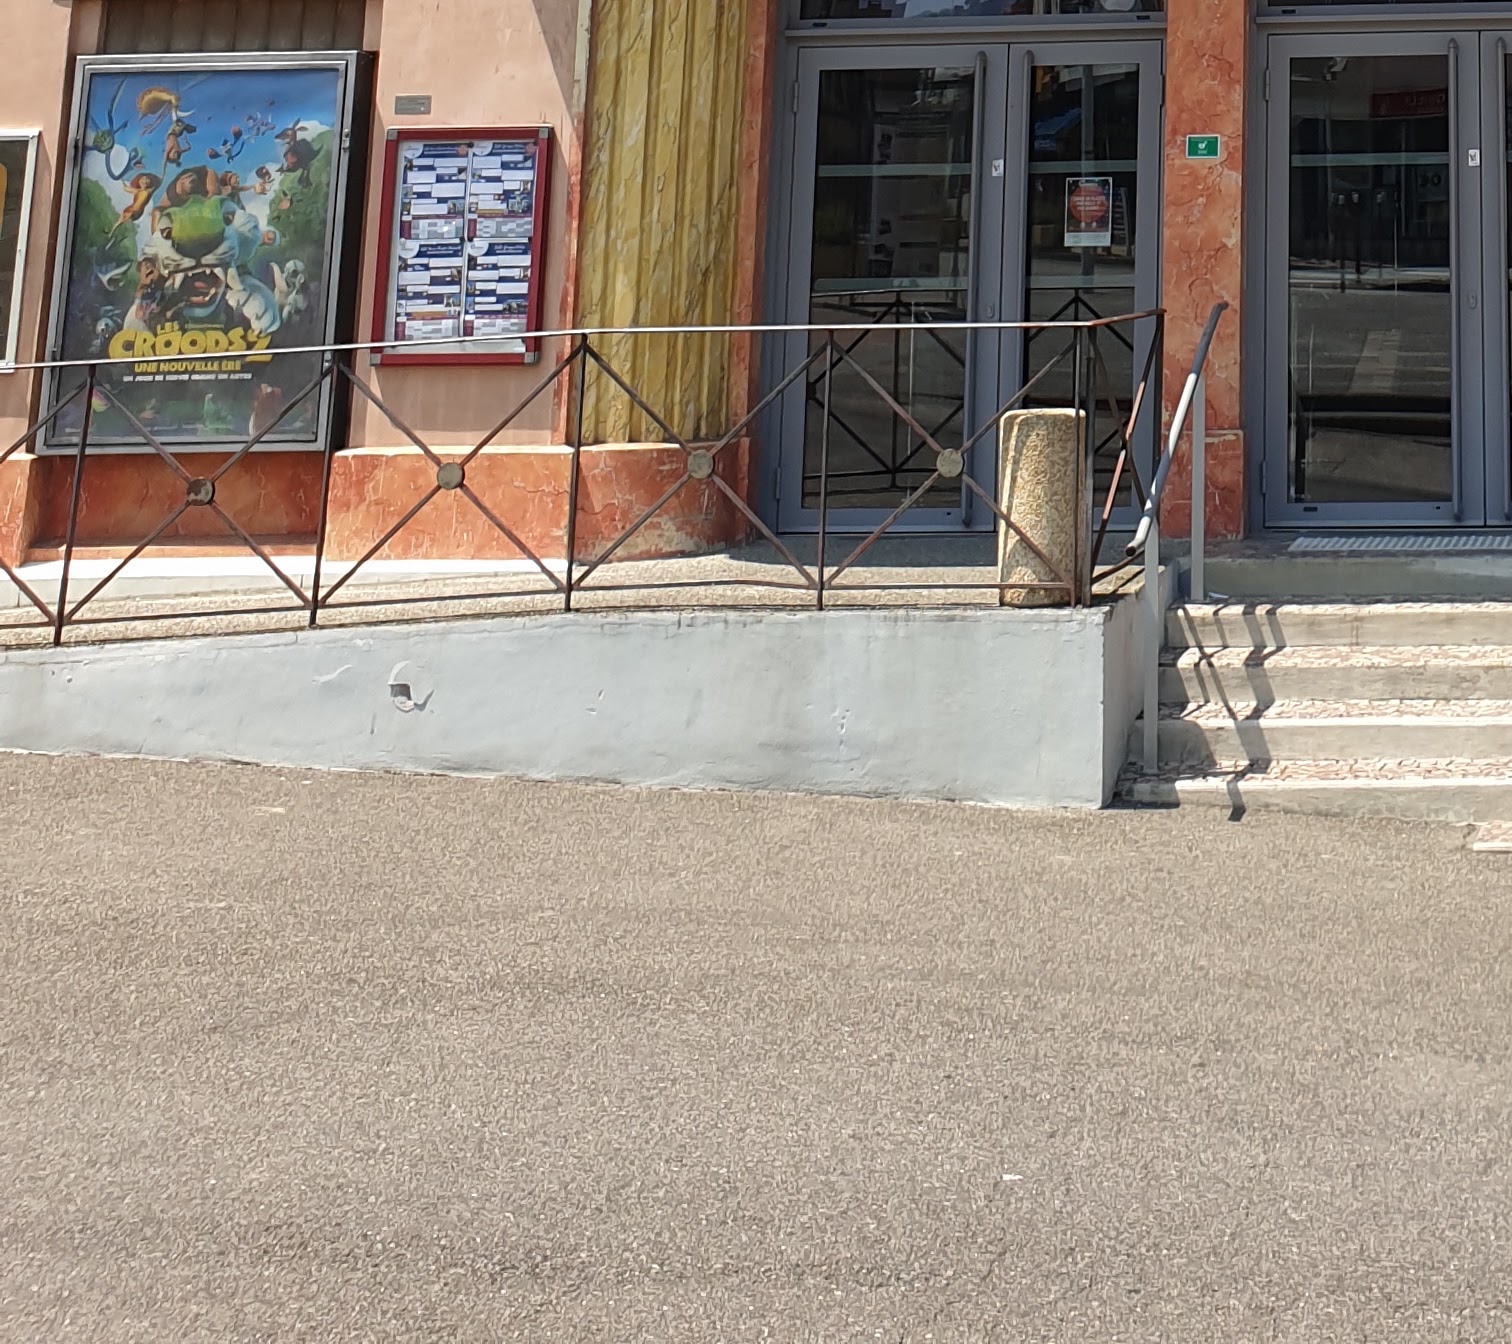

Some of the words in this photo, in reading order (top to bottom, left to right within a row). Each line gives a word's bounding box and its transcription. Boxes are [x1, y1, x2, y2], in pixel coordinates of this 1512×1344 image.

[156, 321, 180, 335] LES
[109, 326, 247, 359] CROODS
[246, 328, 272, 362] 2
[134, 363, 157, 372] UNE
[159, 361, 220, 372] NOUVELLE
